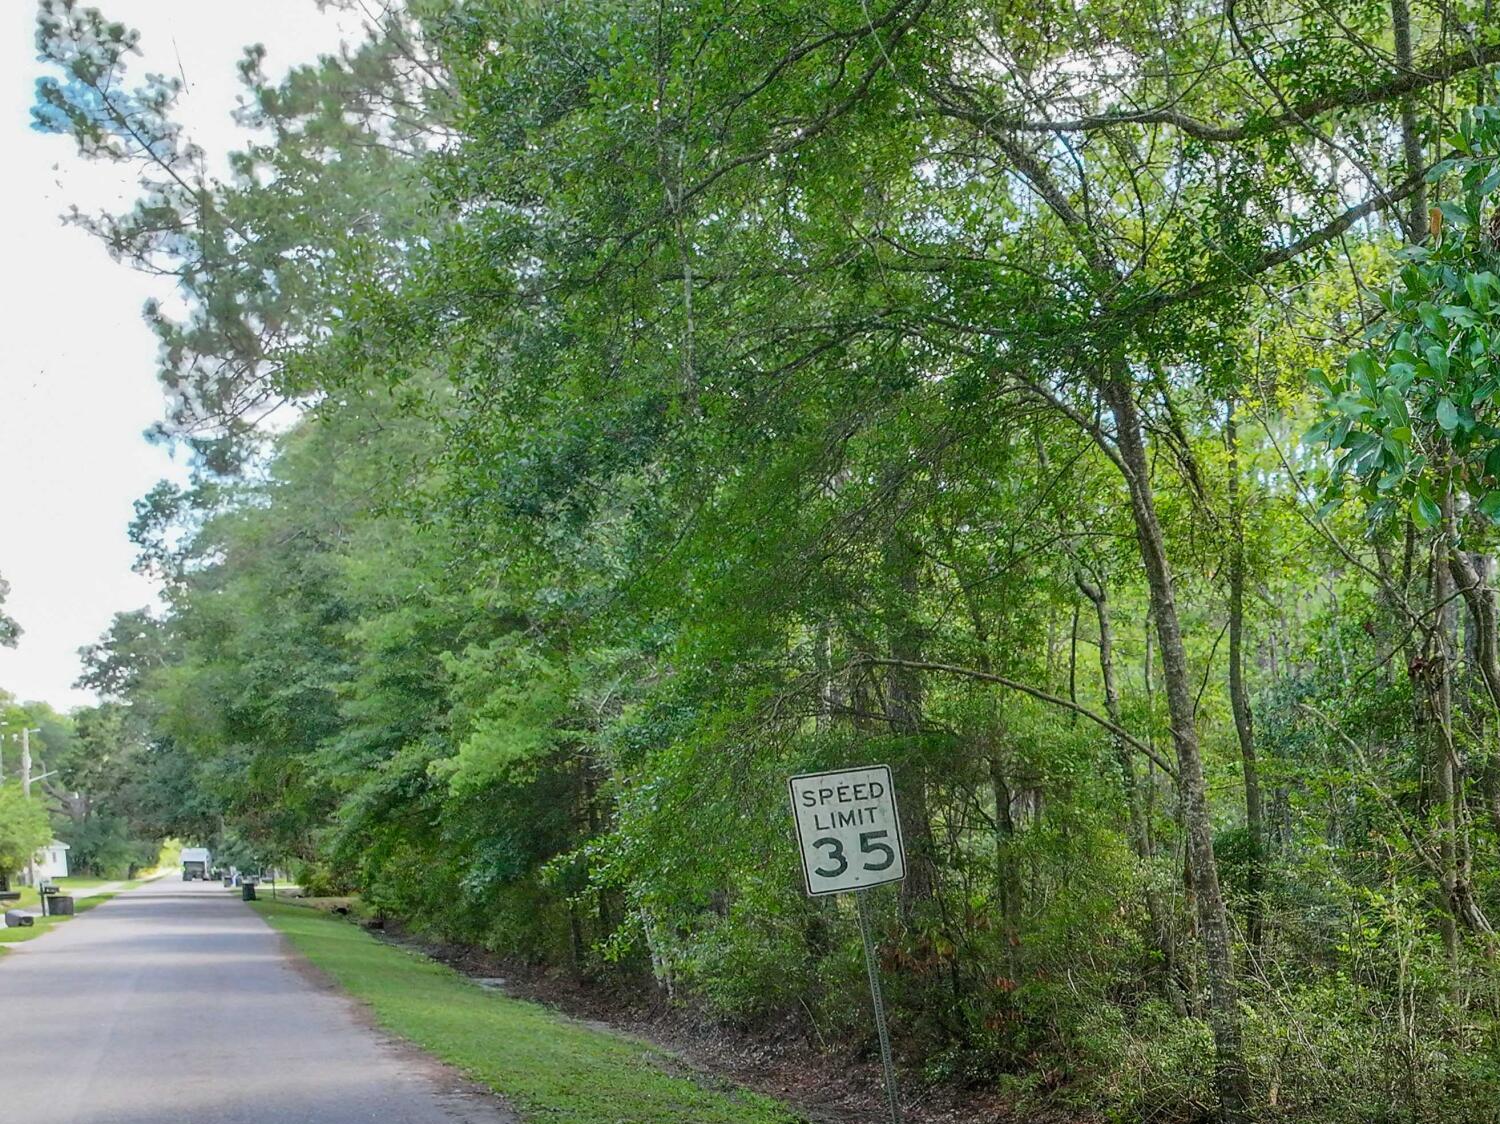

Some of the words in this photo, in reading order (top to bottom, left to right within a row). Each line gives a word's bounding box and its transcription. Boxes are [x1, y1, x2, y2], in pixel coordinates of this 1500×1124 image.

[802, 782, 884, 807] SPEED
[814, 807, 878, 830] LIMIT
[812, 830, 895, 878] 35
